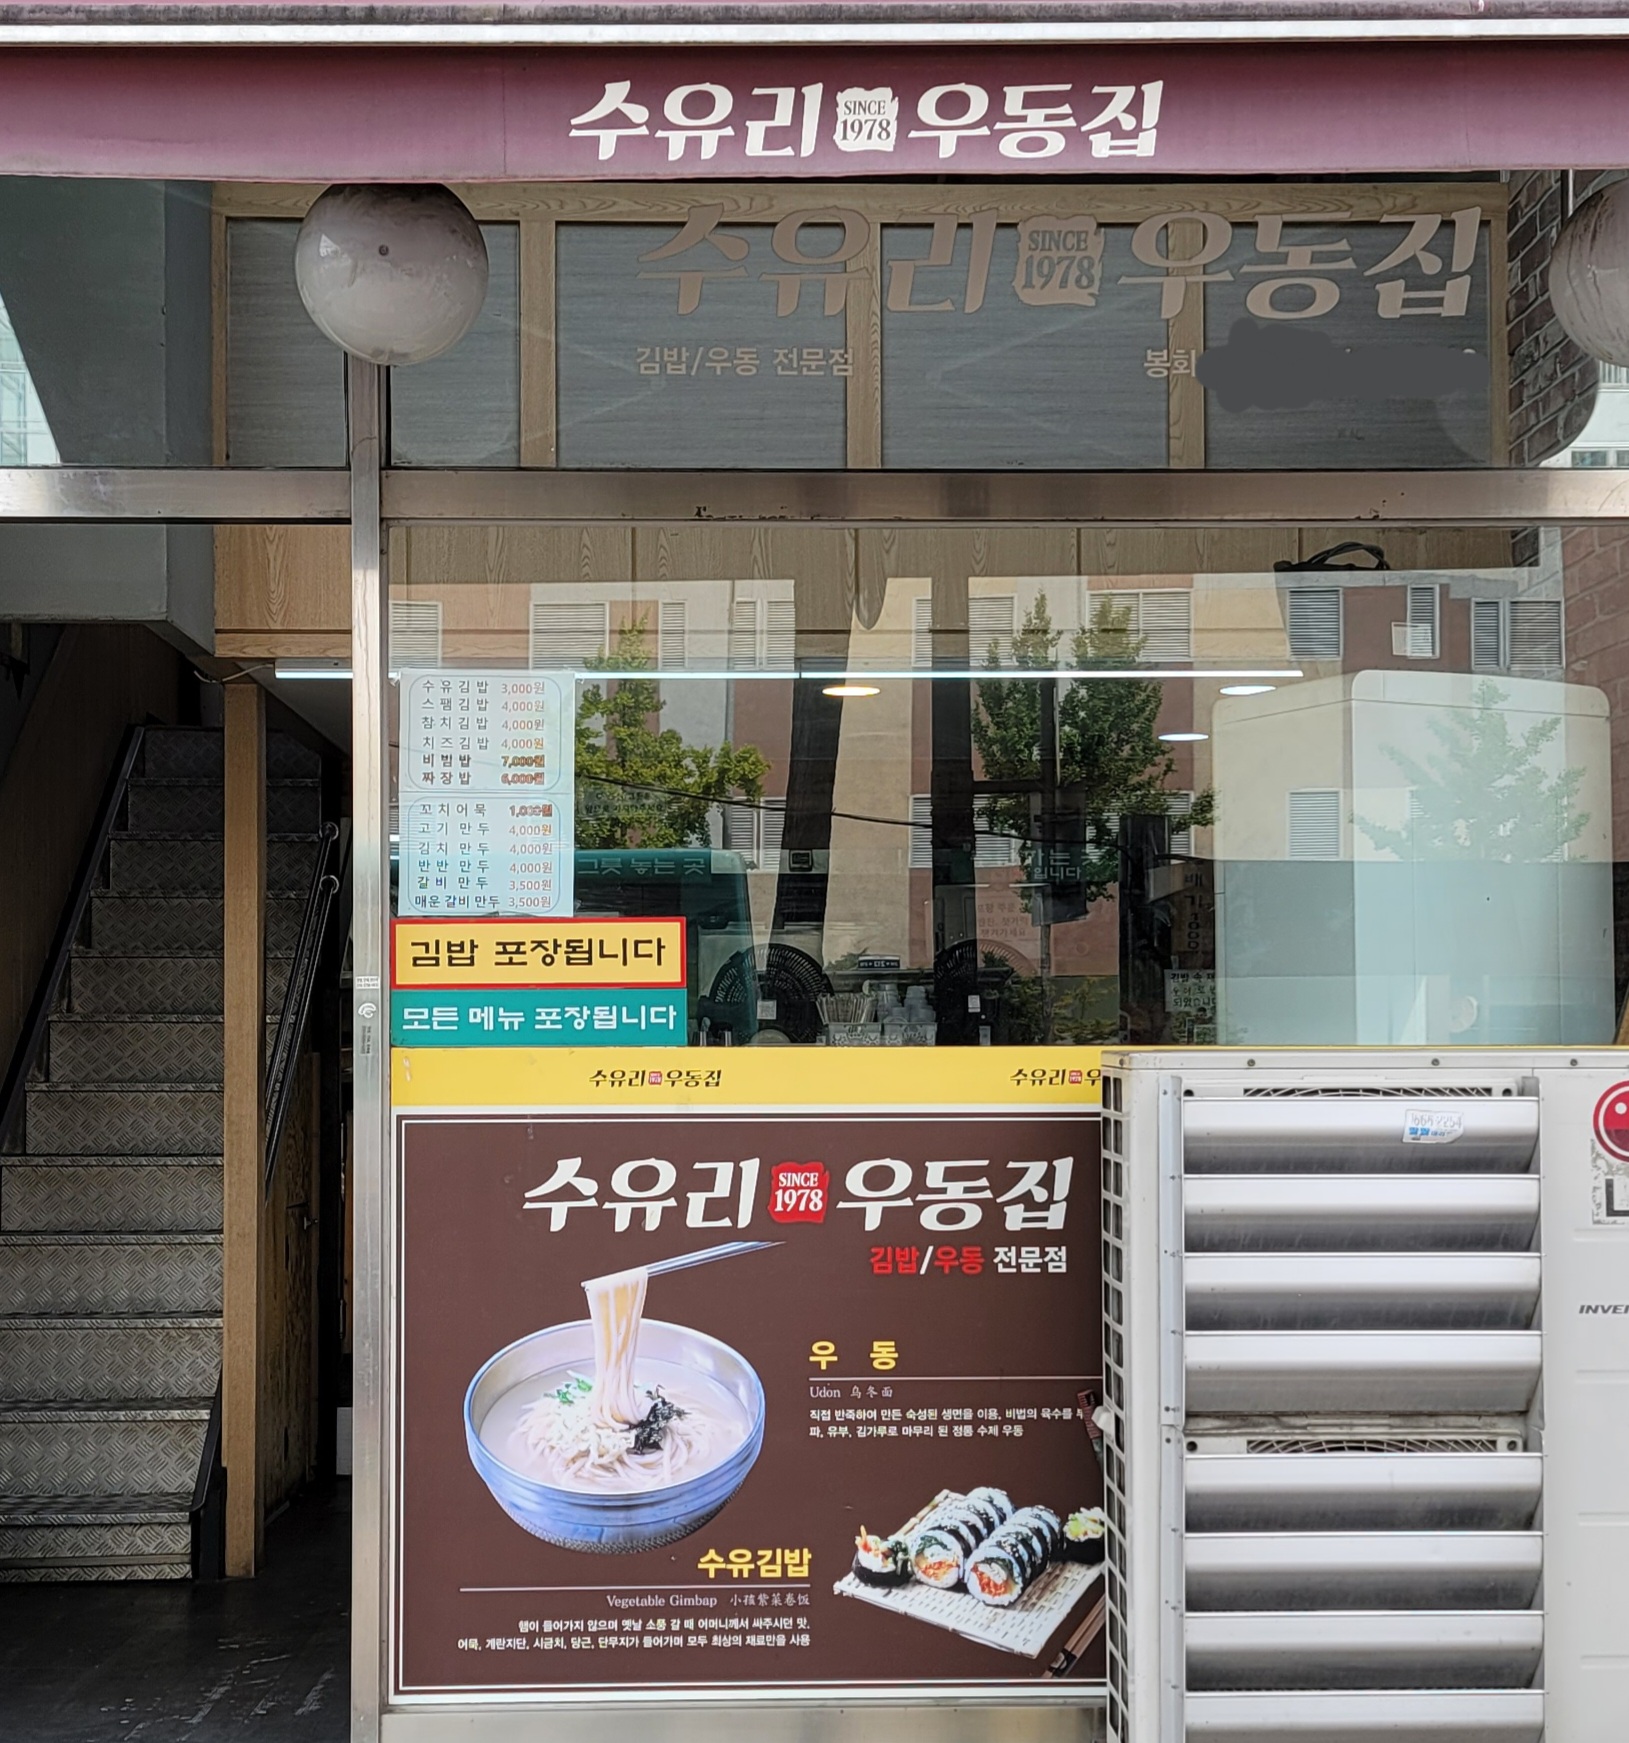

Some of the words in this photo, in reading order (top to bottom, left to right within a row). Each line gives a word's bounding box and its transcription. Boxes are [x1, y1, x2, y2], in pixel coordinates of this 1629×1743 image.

[569, 79, 824, 162] 수유리
[906, 78, 1165, 161] 우동집
[843, 100, 888, 117] SINCE
[839, 117, 892, 143] 1978
[1027, 228, 1090, 254] SINCE
[635, 203, 1000, 317] 수유리
[1116, 206, 1482, 320] 우동집
[1022, 254, 1095, 292] 1978
[636, 347, 760, 376] 김밥/우동
[773, 347, 854, 377] 전문점
[410, 939, 478, 968] 김밥
[493, 937, 666, 967] 포장됩니다
[402, 1006, 460, 1031] 모든
[468, 1006, 526, 1031] 메뉴
[533, 1005, 678, 1031] 포장됩니다
[590, 1069, 645, 1088] 수유리
[665, 1069, 722, 1088] 우동집
[1010, 1068, 1066, 1087] 수유리
[778, 1172, 819, 1187] SINCE
[522, 1156, 760, 1232] 수유리
[836, 1156, 1074, 1232] 우동집
[774, 1188, 824, 1212] 1978
[869, 1245, 985, 1275] 김밥/우동
[993, 1246, 1068, 1273] 전문점
[810, 1386, 841, 1398] Udon
[809, 1408, 831, 1420] 직접
[881, 1408, 902, 1420] 만든
[905, 1408, 938, 1420] 숙성된
[1005, 1408, 1037, 1420] 비법의
[1041, 1408, 1073, 1420] 육수를
[856, 1425, 898, 1438] 김가루로
[902, 1425, 934, 1438] 마무리
[938, 1425, 948, 1438] 된
[977, 1425, 999, 1438] 수제
[1002, 1425, 1024, 1438] 우동
[697, 1548, 812, 1578] 수유김밥
[606, 1594, 666, 1608] Vegetable
[669, 1594, 718, 1608] Gimbap
[543, 1620, 584, 1632] 들어가지
[645, 1618, 667, 1631] 소풍
[670, 1618, 681, 1631] 갈
[684, 1618, 695, 1631] 때
[698, 1617, 749, 1630] 어머니께서
[752, 1617, 794, 1630] 싸주시던
[598, 1635, 640, 1649] 단무지가
[687, 1635, 709, 1647] 모두
[711, 1634, 743, 1647] 최상의
[745, 1634, 787, 1647] 재료만을
[789, 1633, 811, 1647] 사용
